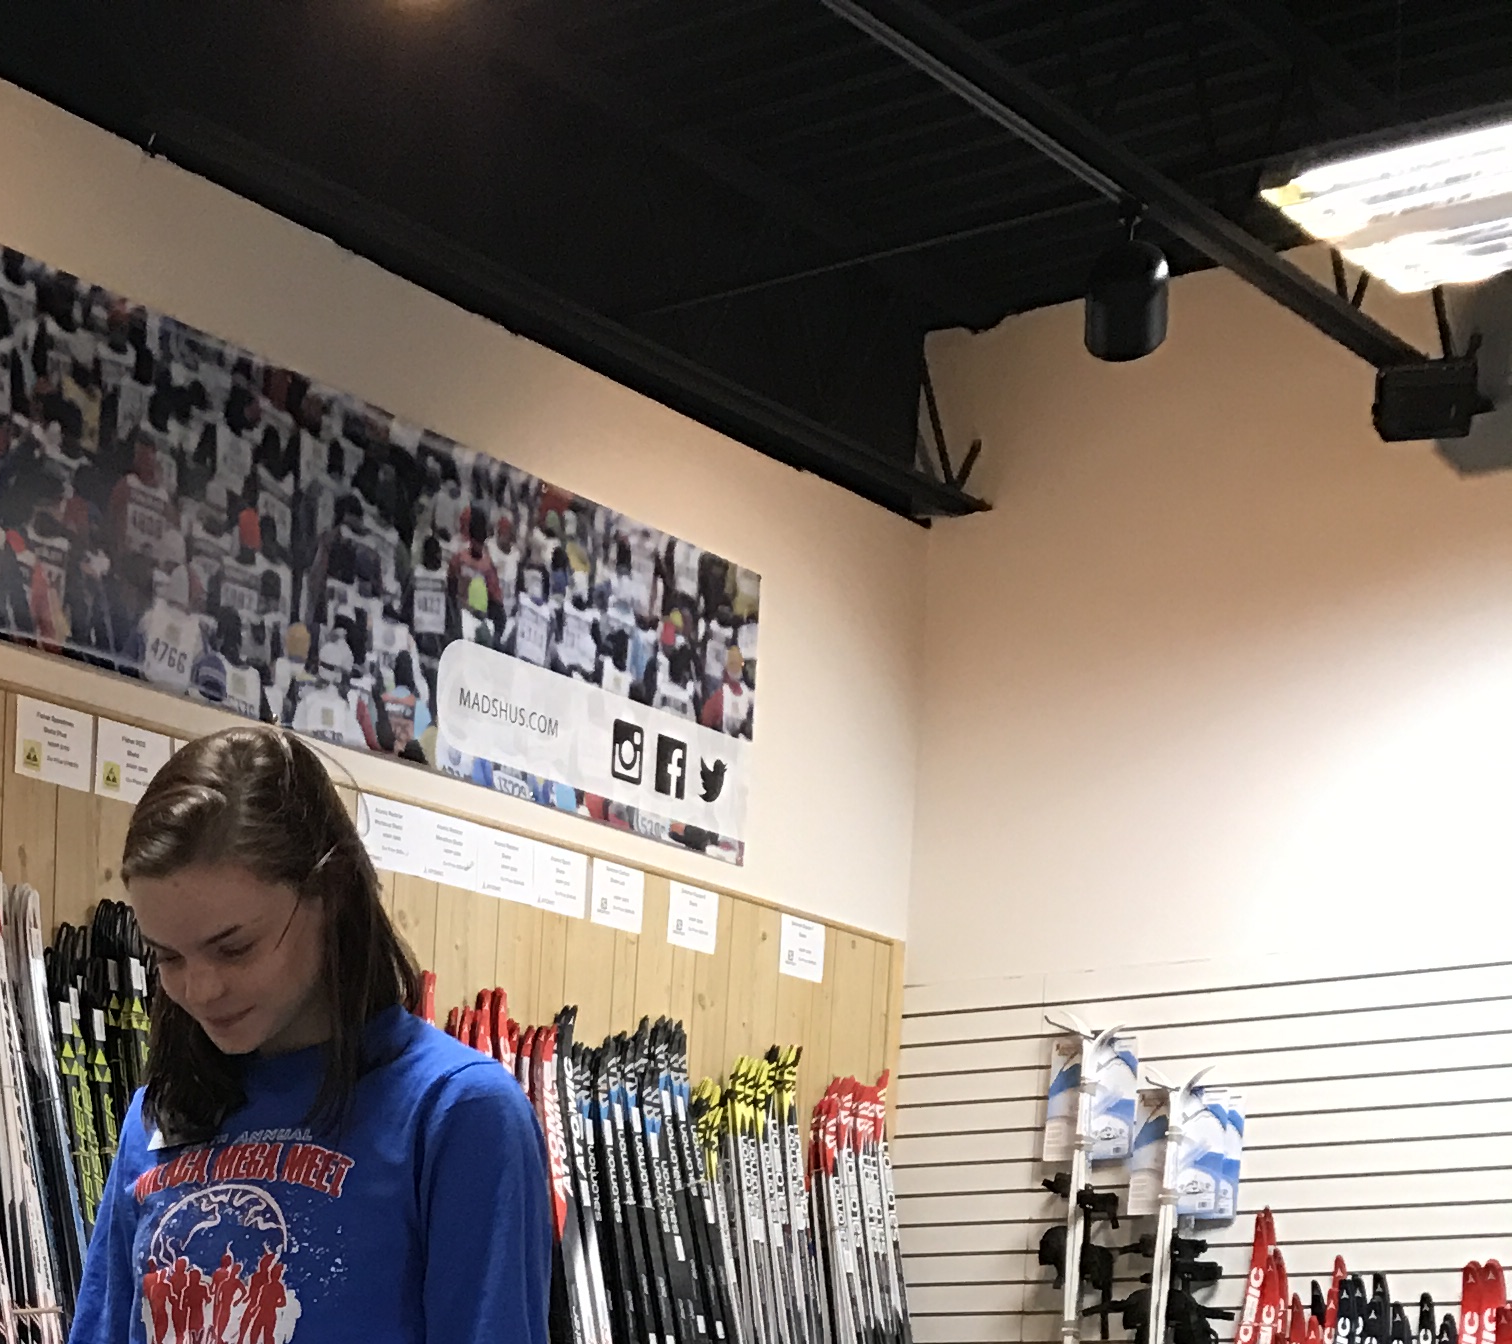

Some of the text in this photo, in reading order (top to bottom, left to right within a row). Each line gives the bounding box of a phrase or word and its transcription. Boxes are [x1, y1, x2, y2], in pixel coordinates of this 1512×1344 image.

[458, 687, 559, 739] MADSHUS.COM
[211, 1141, 356, 1198] MEGA MEET
